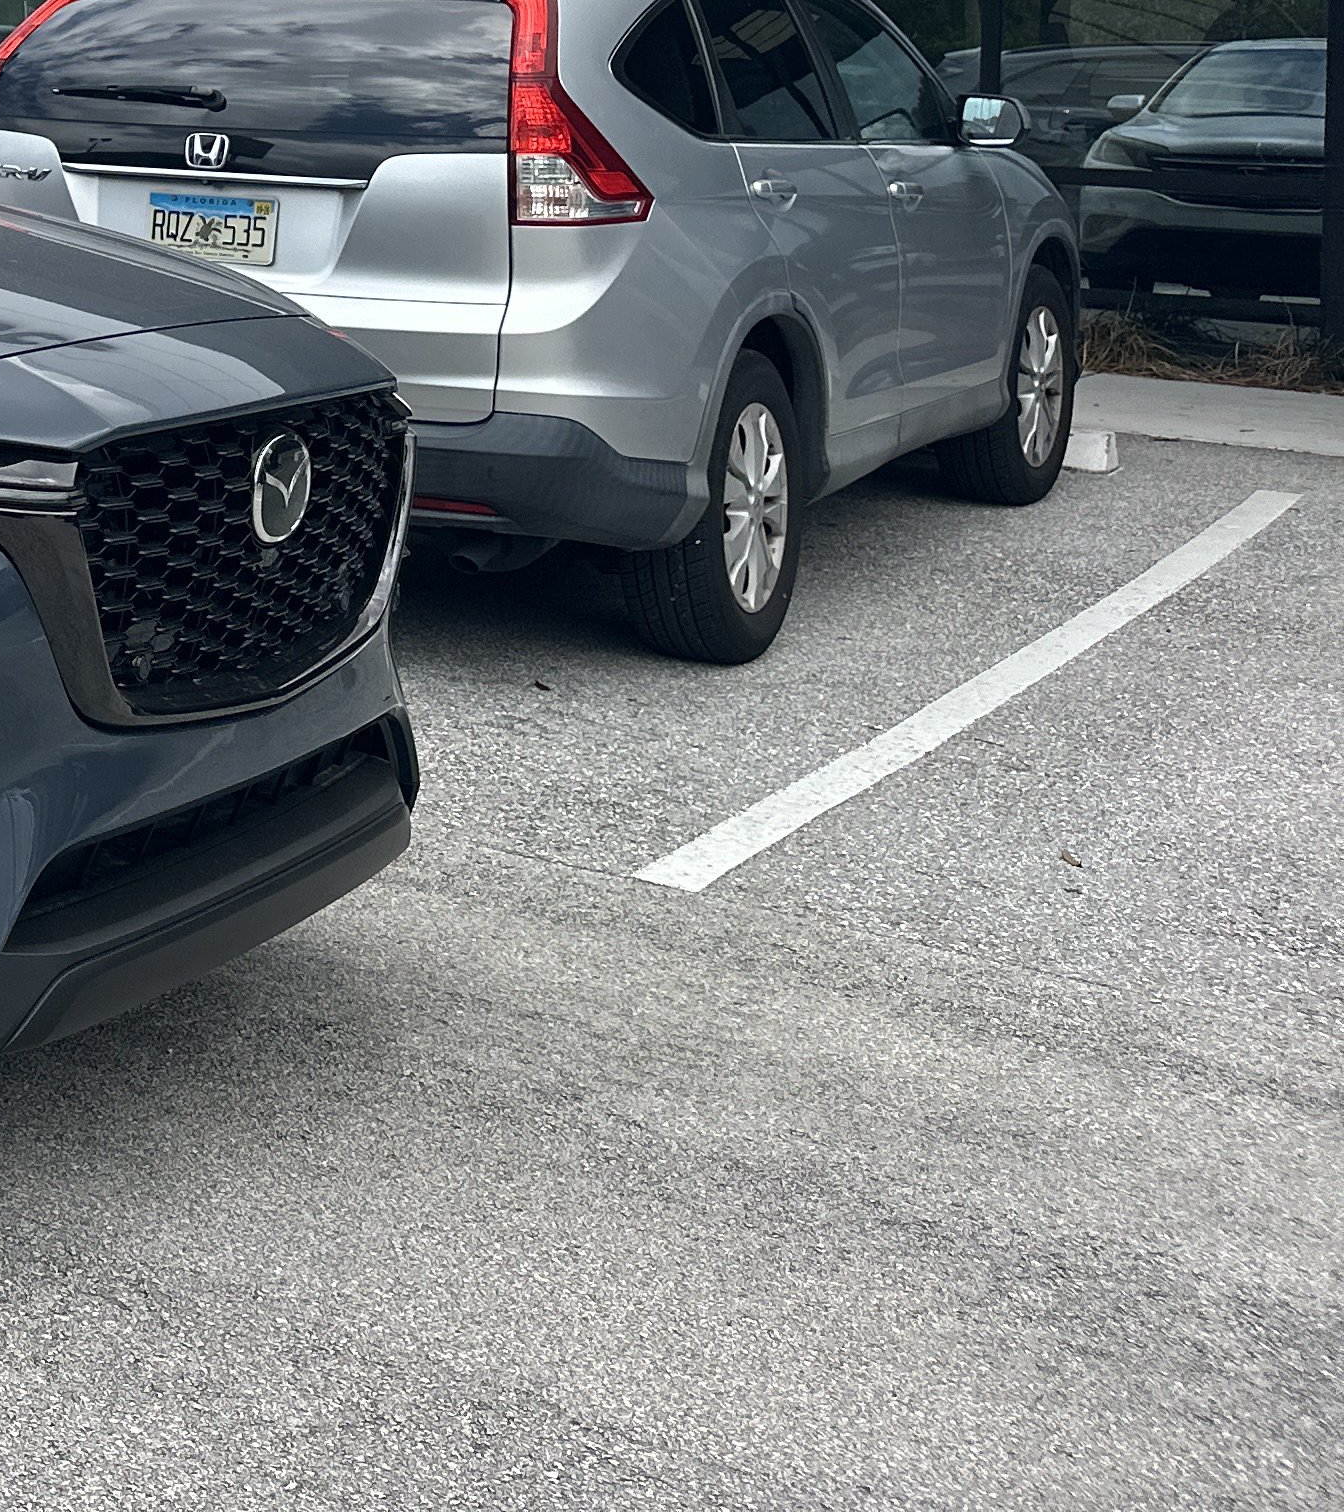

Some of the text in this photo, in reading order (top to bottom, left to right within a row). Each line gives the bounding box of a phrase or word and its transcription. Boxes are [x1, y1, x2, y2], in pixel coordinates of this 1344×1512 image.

[185, 196, 237, 207] FLORIDA
[150, 209, 267, 249] RQZ 535
